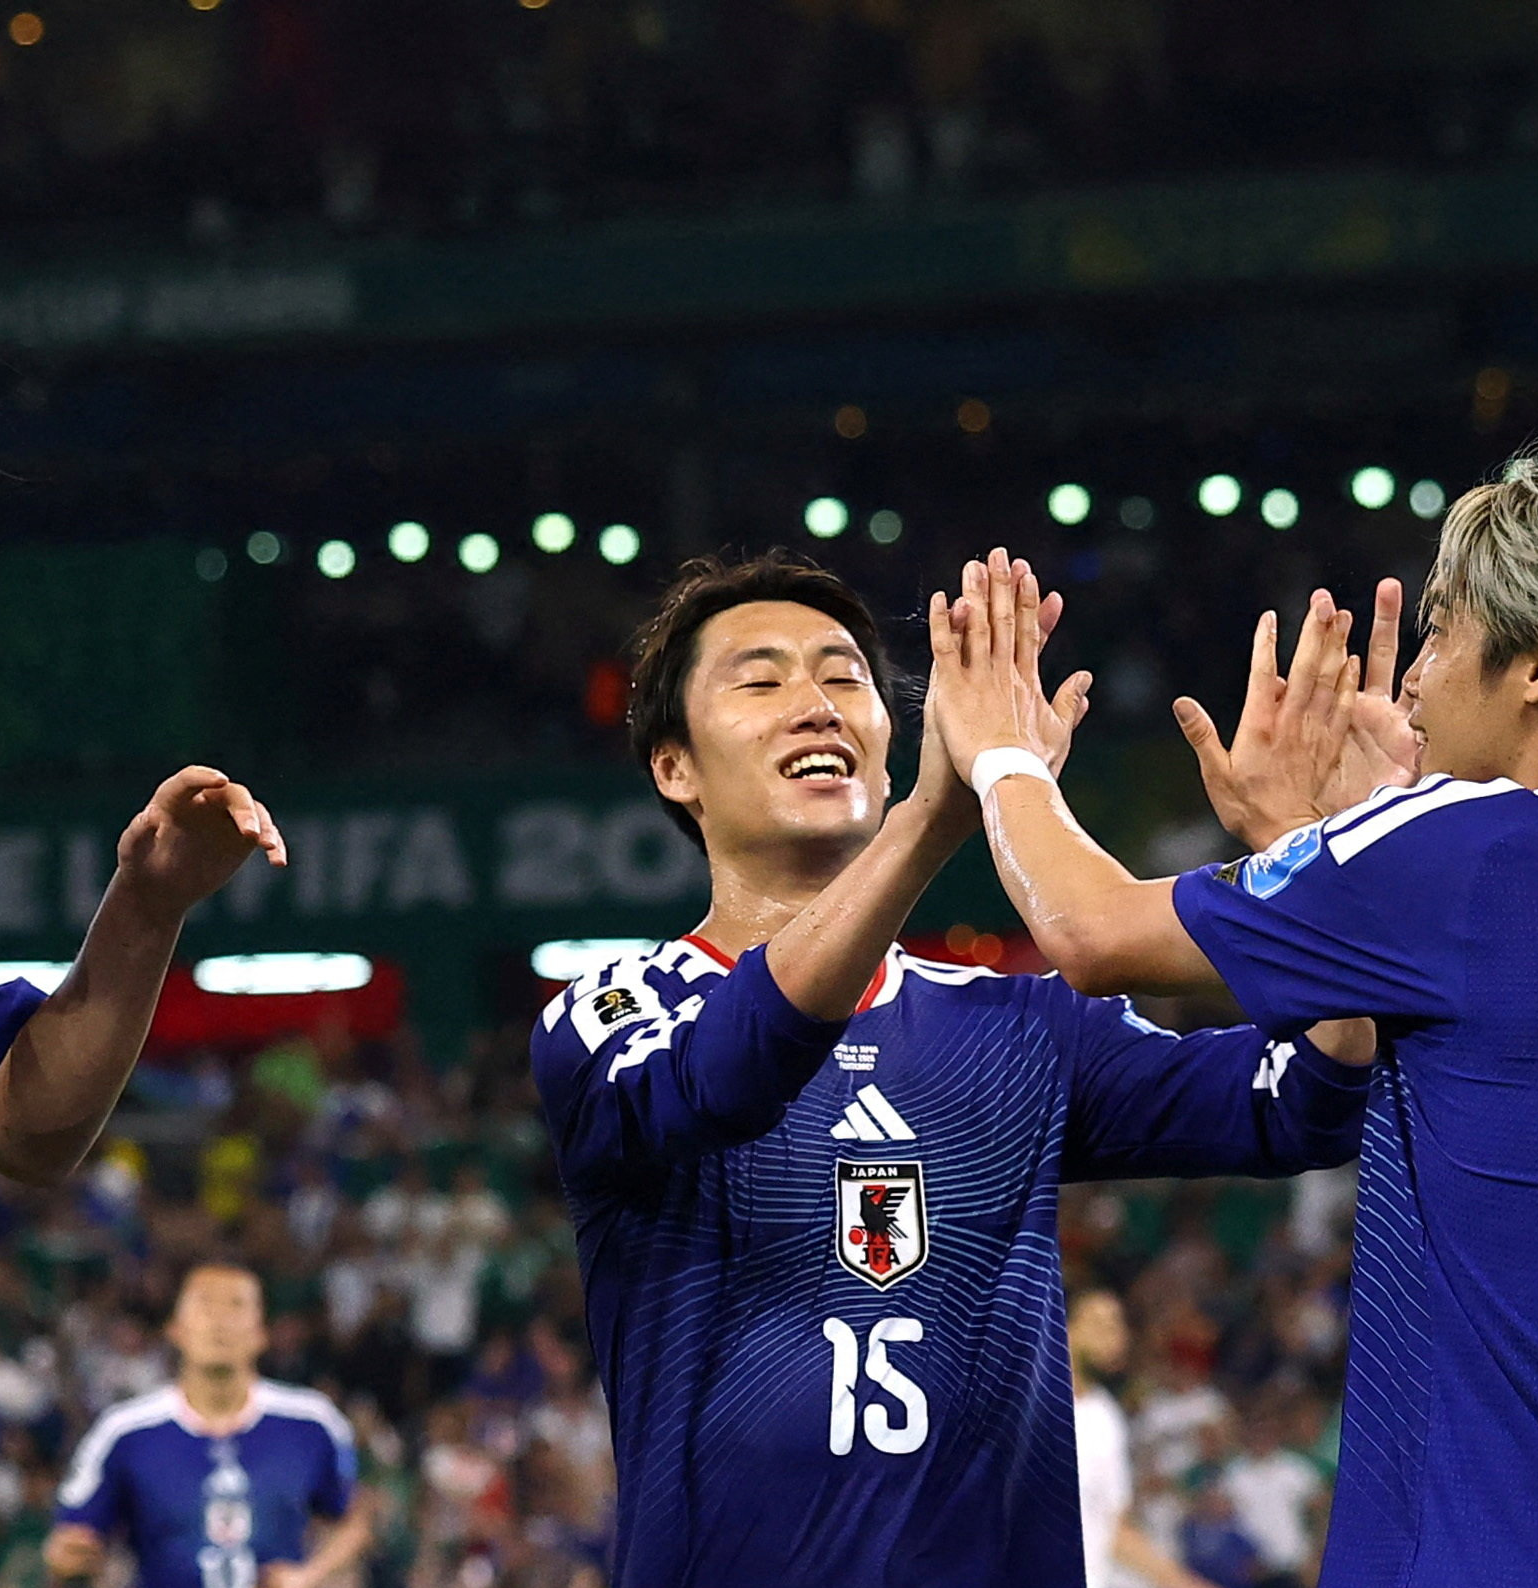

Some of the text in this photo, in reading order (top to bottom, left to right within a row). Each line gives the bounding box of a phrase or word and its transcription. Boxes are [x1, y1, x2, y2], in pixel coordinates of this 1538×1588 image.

[851, 1167, 898, 1178] JAPAN
[859, 1246, 901, 1267] JFA
[823, 1317, 929, 1456] 15
